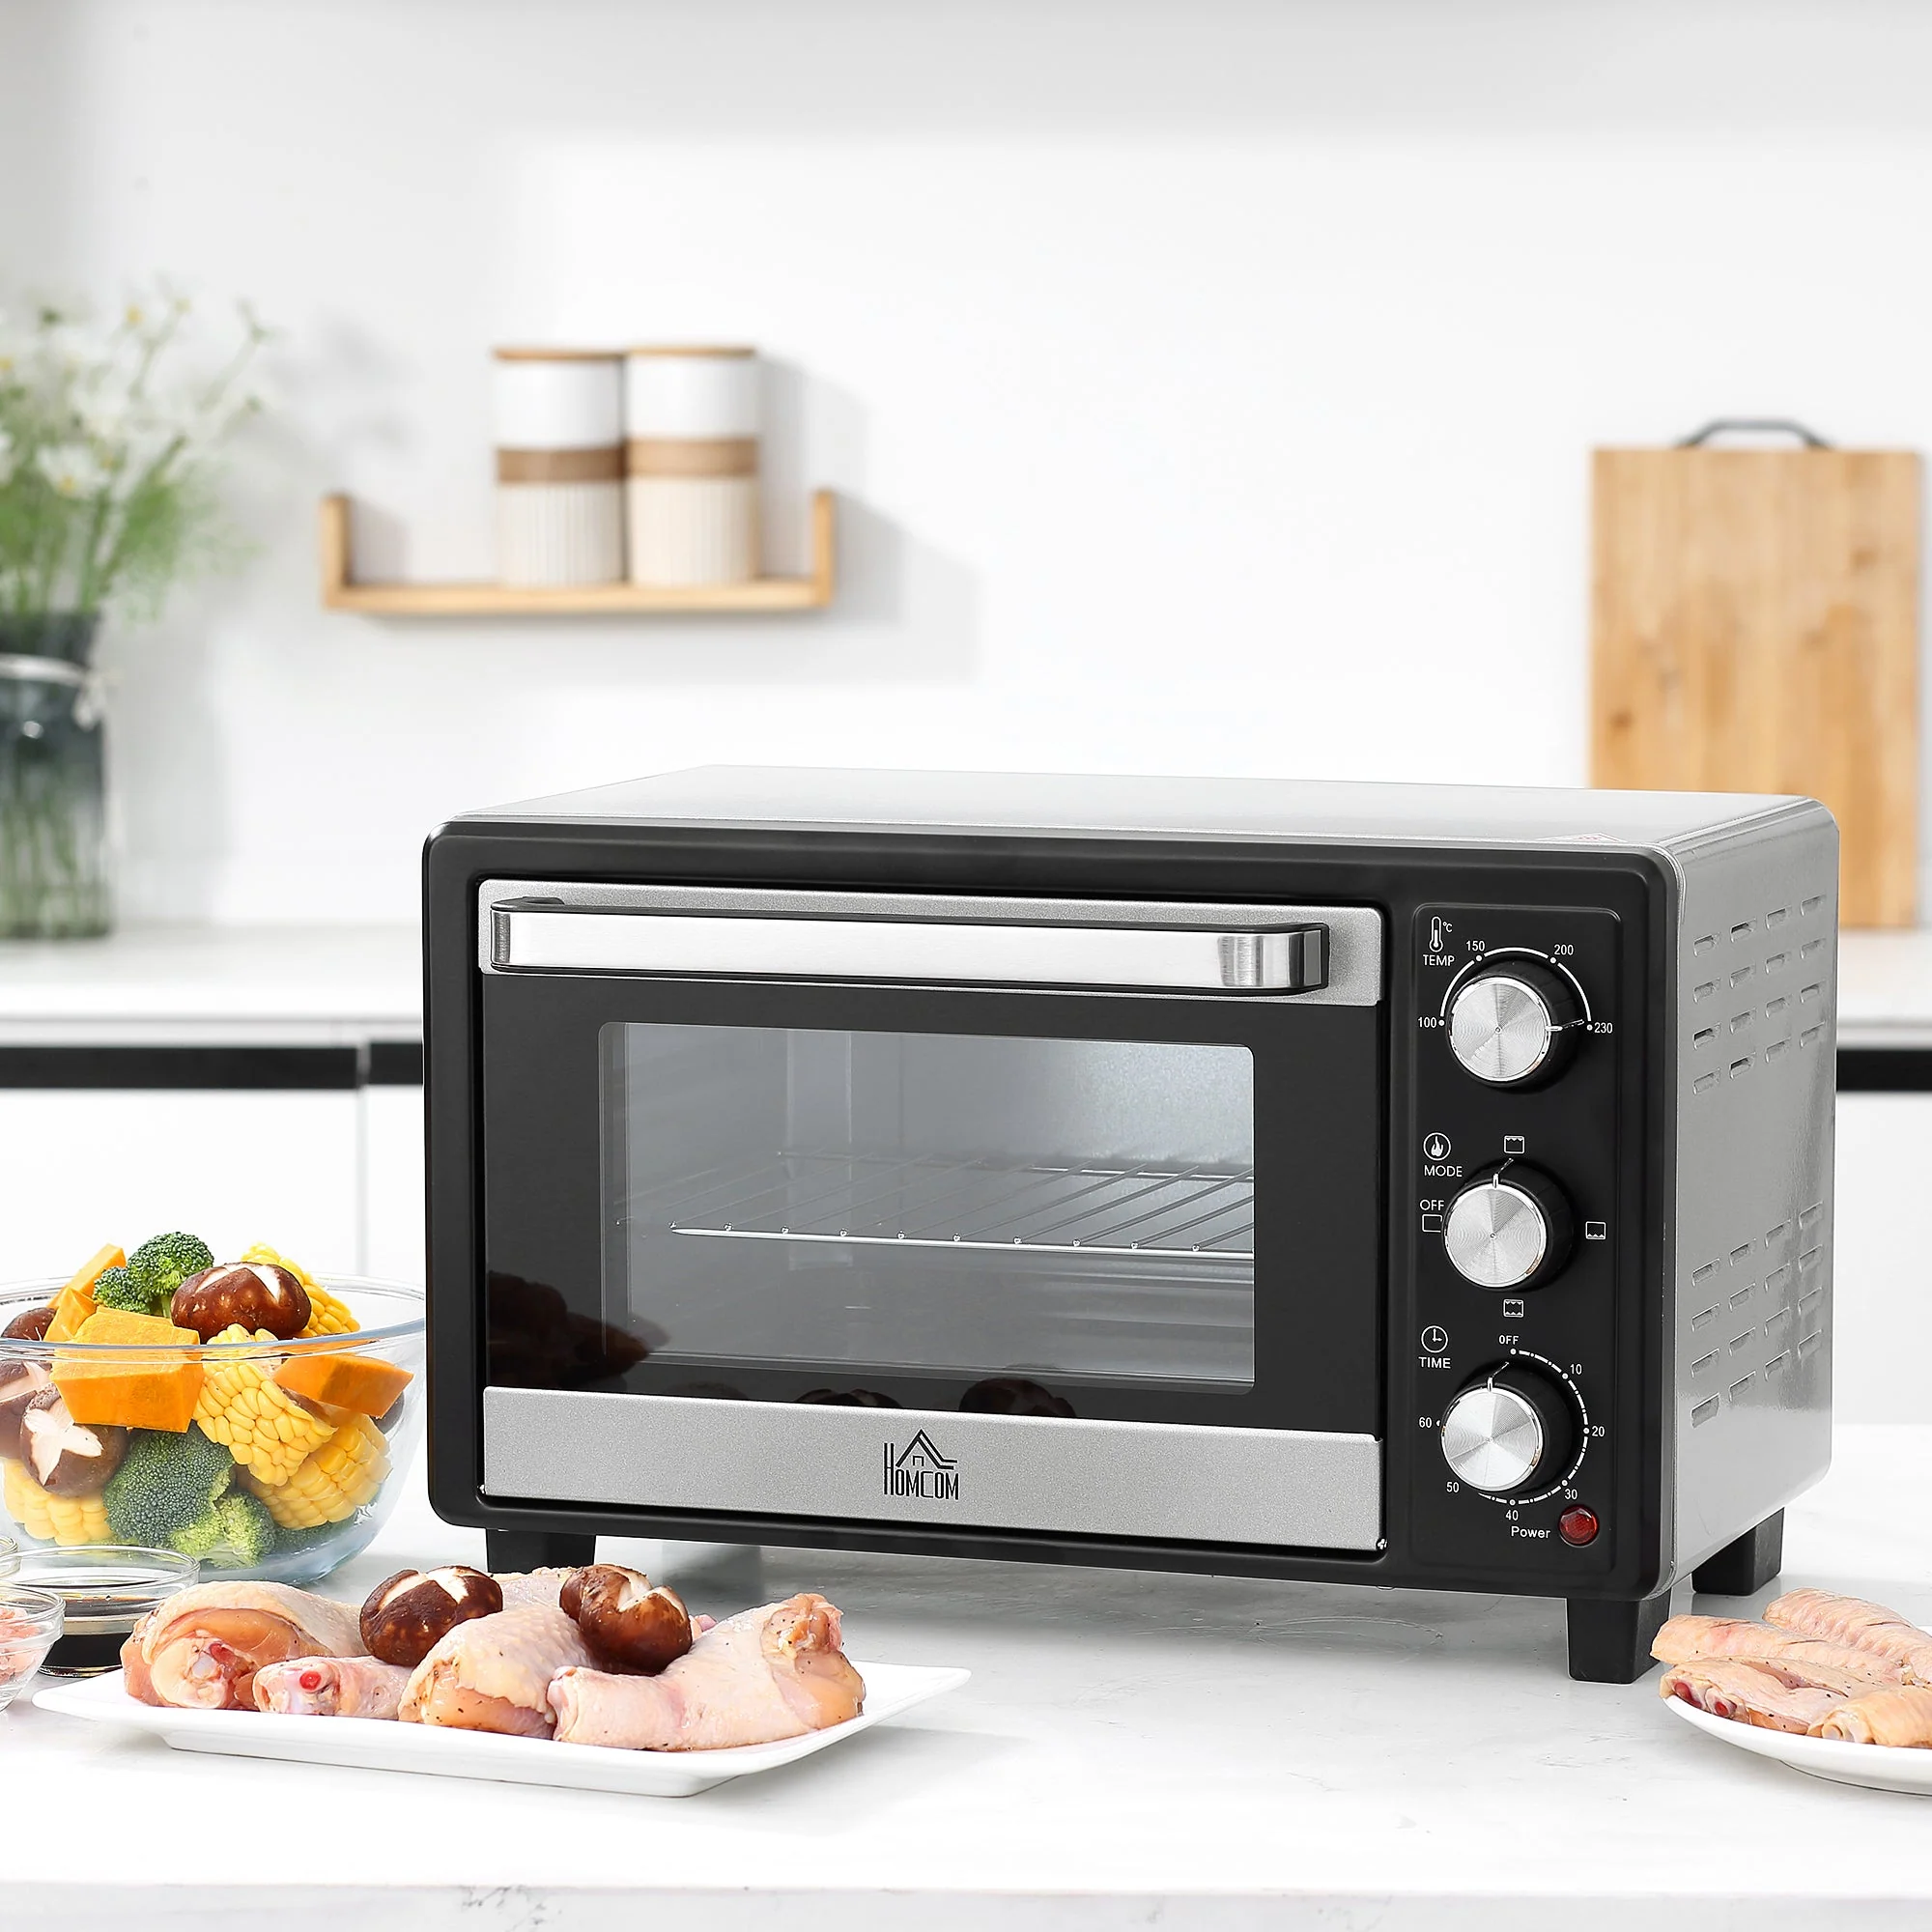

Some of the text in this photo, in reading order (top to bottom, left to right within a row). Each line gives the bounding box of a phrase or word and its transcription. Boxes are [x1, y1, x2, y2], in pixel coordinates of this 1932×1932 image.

[1465, 940, 1486, 952] 150
[1553, 944, 1575, 955] 200
[1422, 953, 1456, 967] TEMP
[1417, 1017, 1437, 1028] 100
[1594, 1023, 1613, 1034] 230
[1424, 1164, 1463, 1178] MODE
[1419, 1199, 1445, 1211] OFF
[1498, 1334, 1520, 1346] OFF
[1418, 1356, 1452, 1370] TIME
[1570, 1363, 1583, 1375] 10
[1418, 1416, 1433, 1429] 60
[1591, 1426, 1605, 1437] 20
[1446, 1481, 1460, 1493] 50
[1564, 1489, 1578, 1500] 30
[1505, 1509, 1520, 1521] 40
[1510, 1525, 1551, 1539] Power
